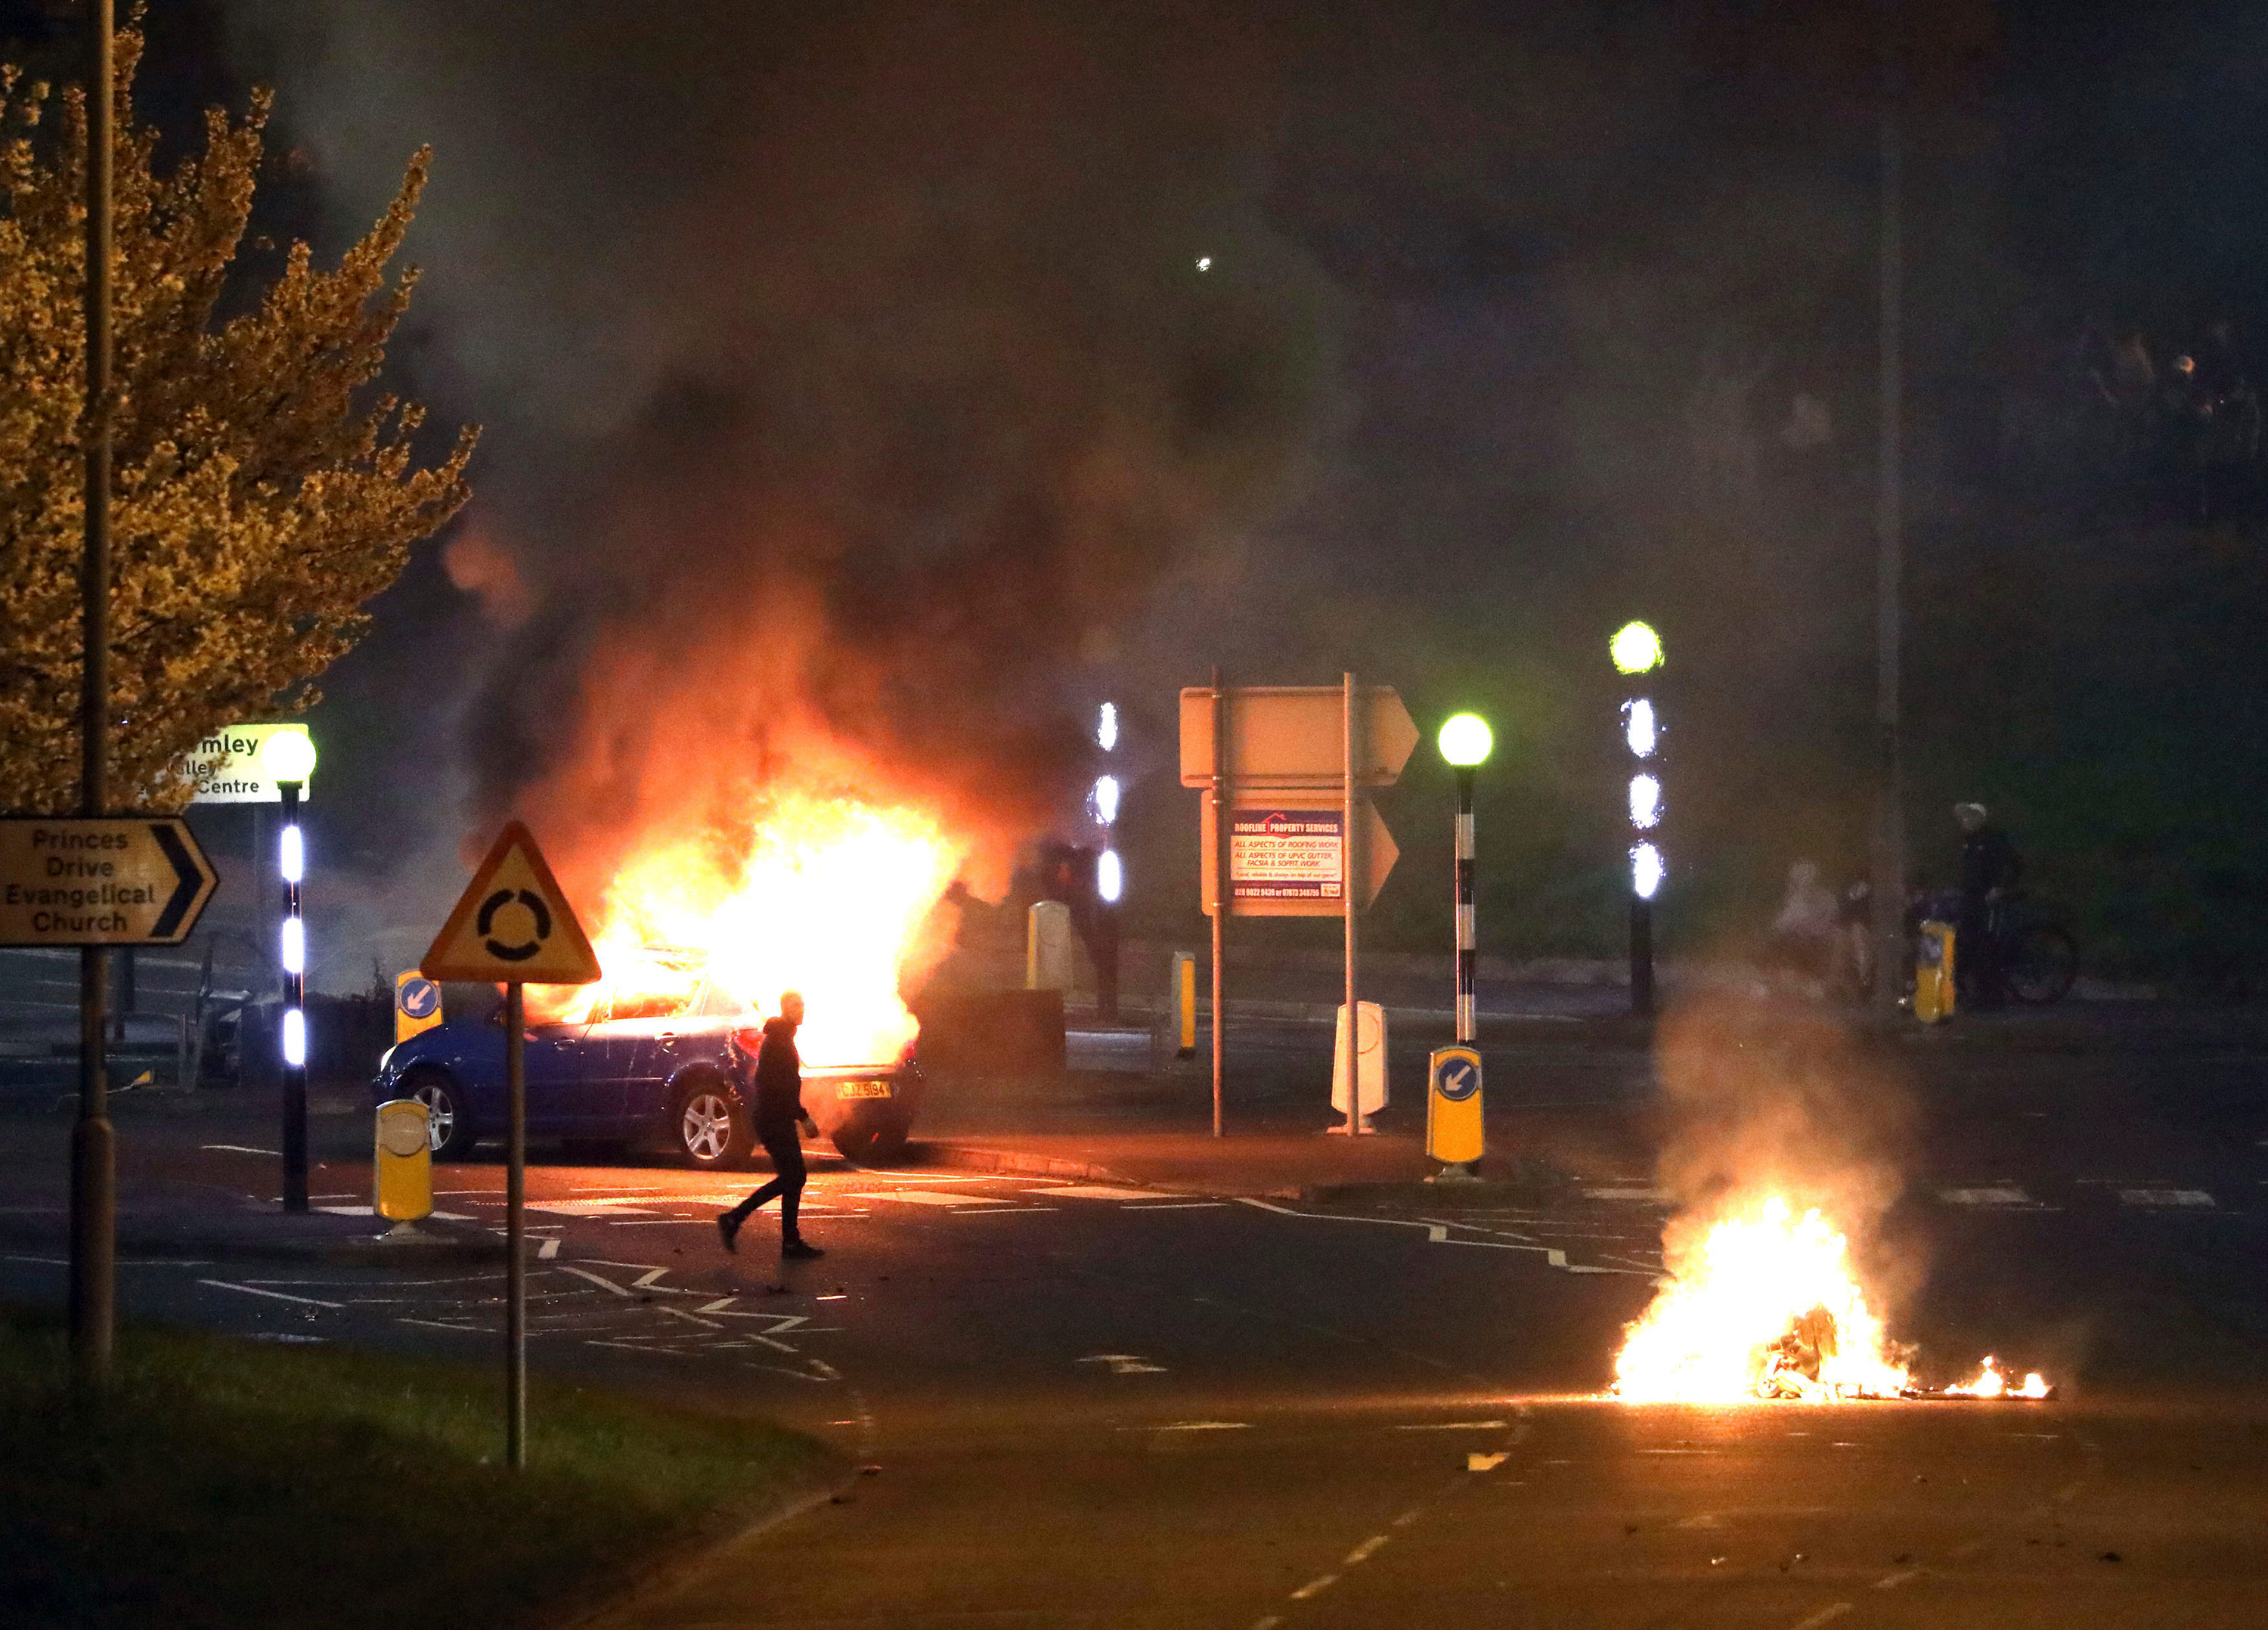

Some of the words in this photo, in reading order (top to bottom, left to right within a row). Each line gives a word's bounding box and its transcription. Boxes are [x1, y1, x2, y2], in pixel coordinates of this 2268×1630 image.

[202, 734, 259, 756] mley
[198, 779, 259, 794] Centre
[1235, 823, 1266, 832] ROOFLINE
[1270, 823, 1304, 832] PROPERTY
[1306, 823, 1338, 833] SERVICES
[33, 829, 129, 850] Princes
[47, 857, 113, 877] Drive
[6, 883, 155, 908] Evangelical
[33, 912, 127, 931] Church
[863, 1083, 885, 1096] 5194
